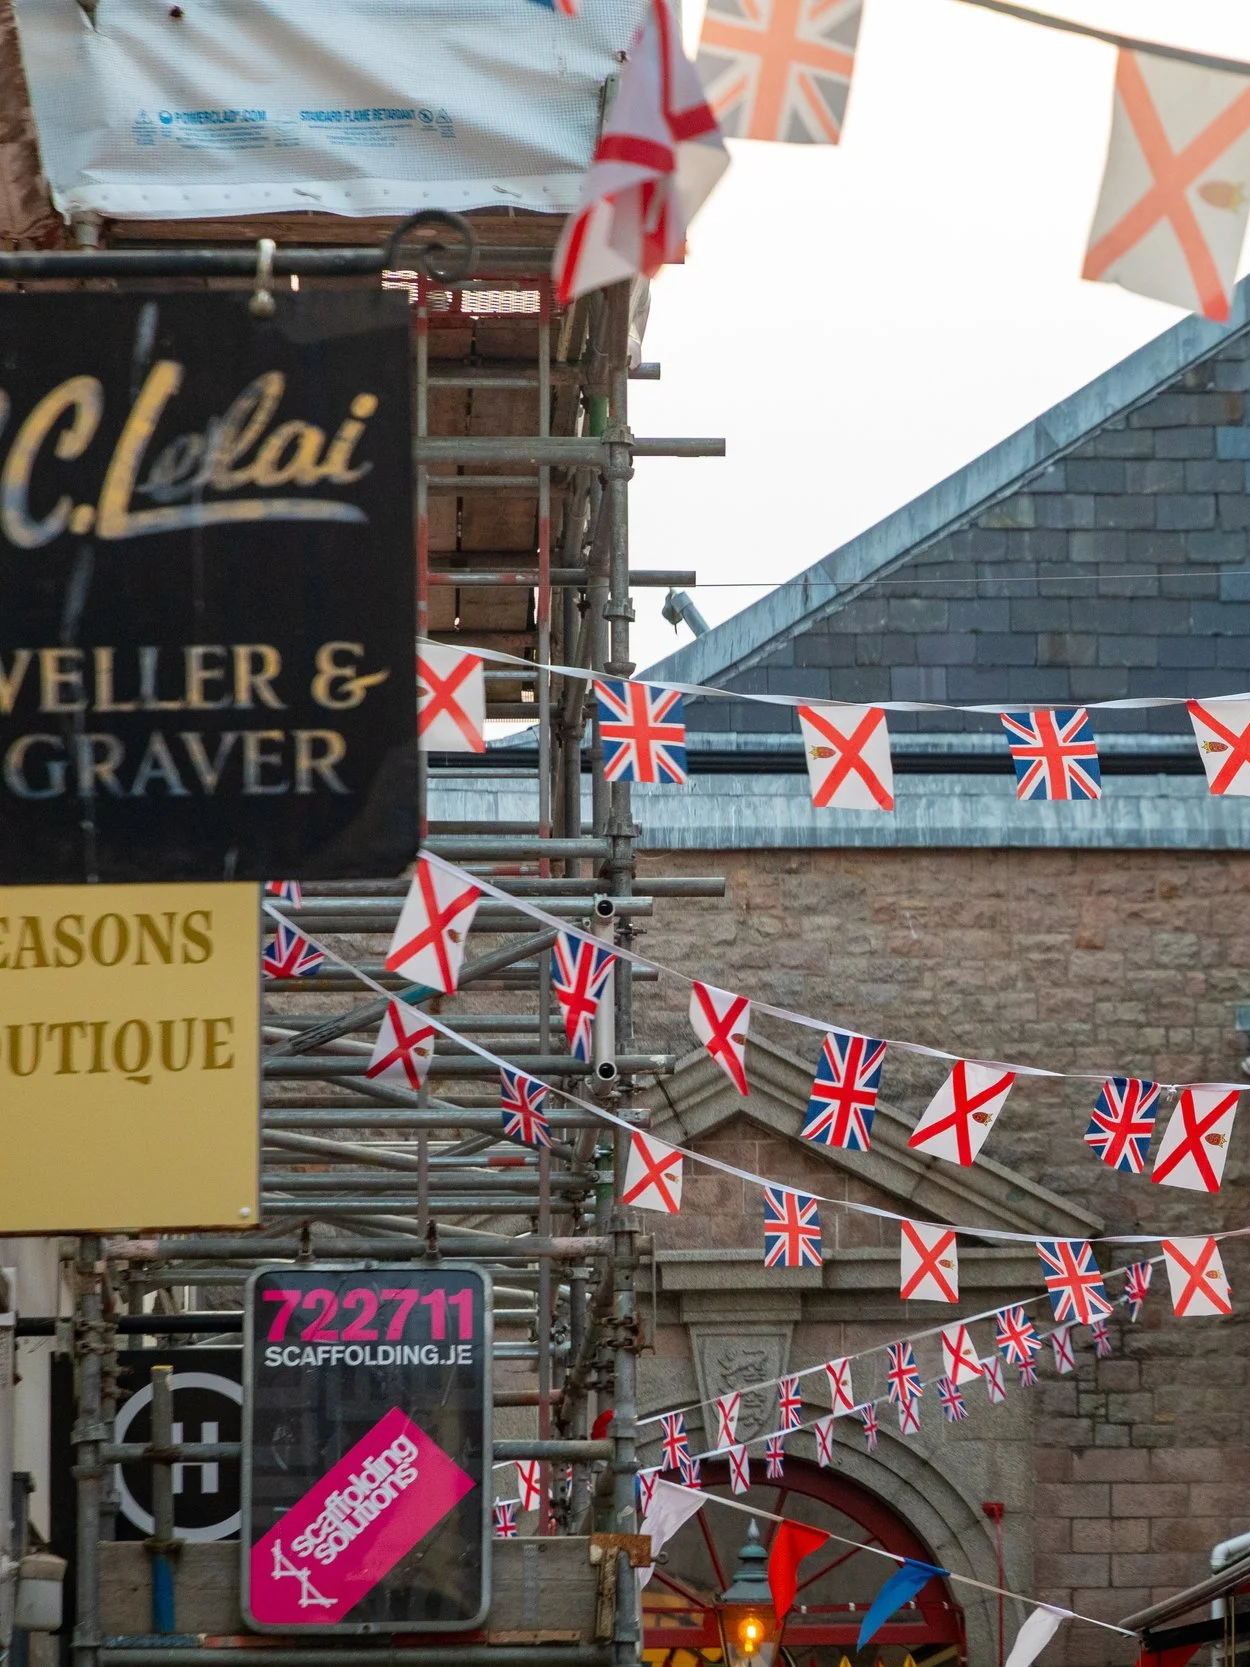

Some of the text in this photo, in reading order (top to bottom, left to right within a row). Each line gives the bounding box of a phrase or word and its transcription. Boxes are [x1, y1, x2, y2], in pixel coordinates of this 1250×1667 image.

[311, 641, 391, 710] &
[3, 729, 351, 799] GRAVER
[263, 1287, 474, 1343] 722711
[264, 1345, 473, 1368] SCAFFOLDING.JE
[291, 1434, 419, 1558] scaffolding
[313, 1462, 419, 1566] solutions
